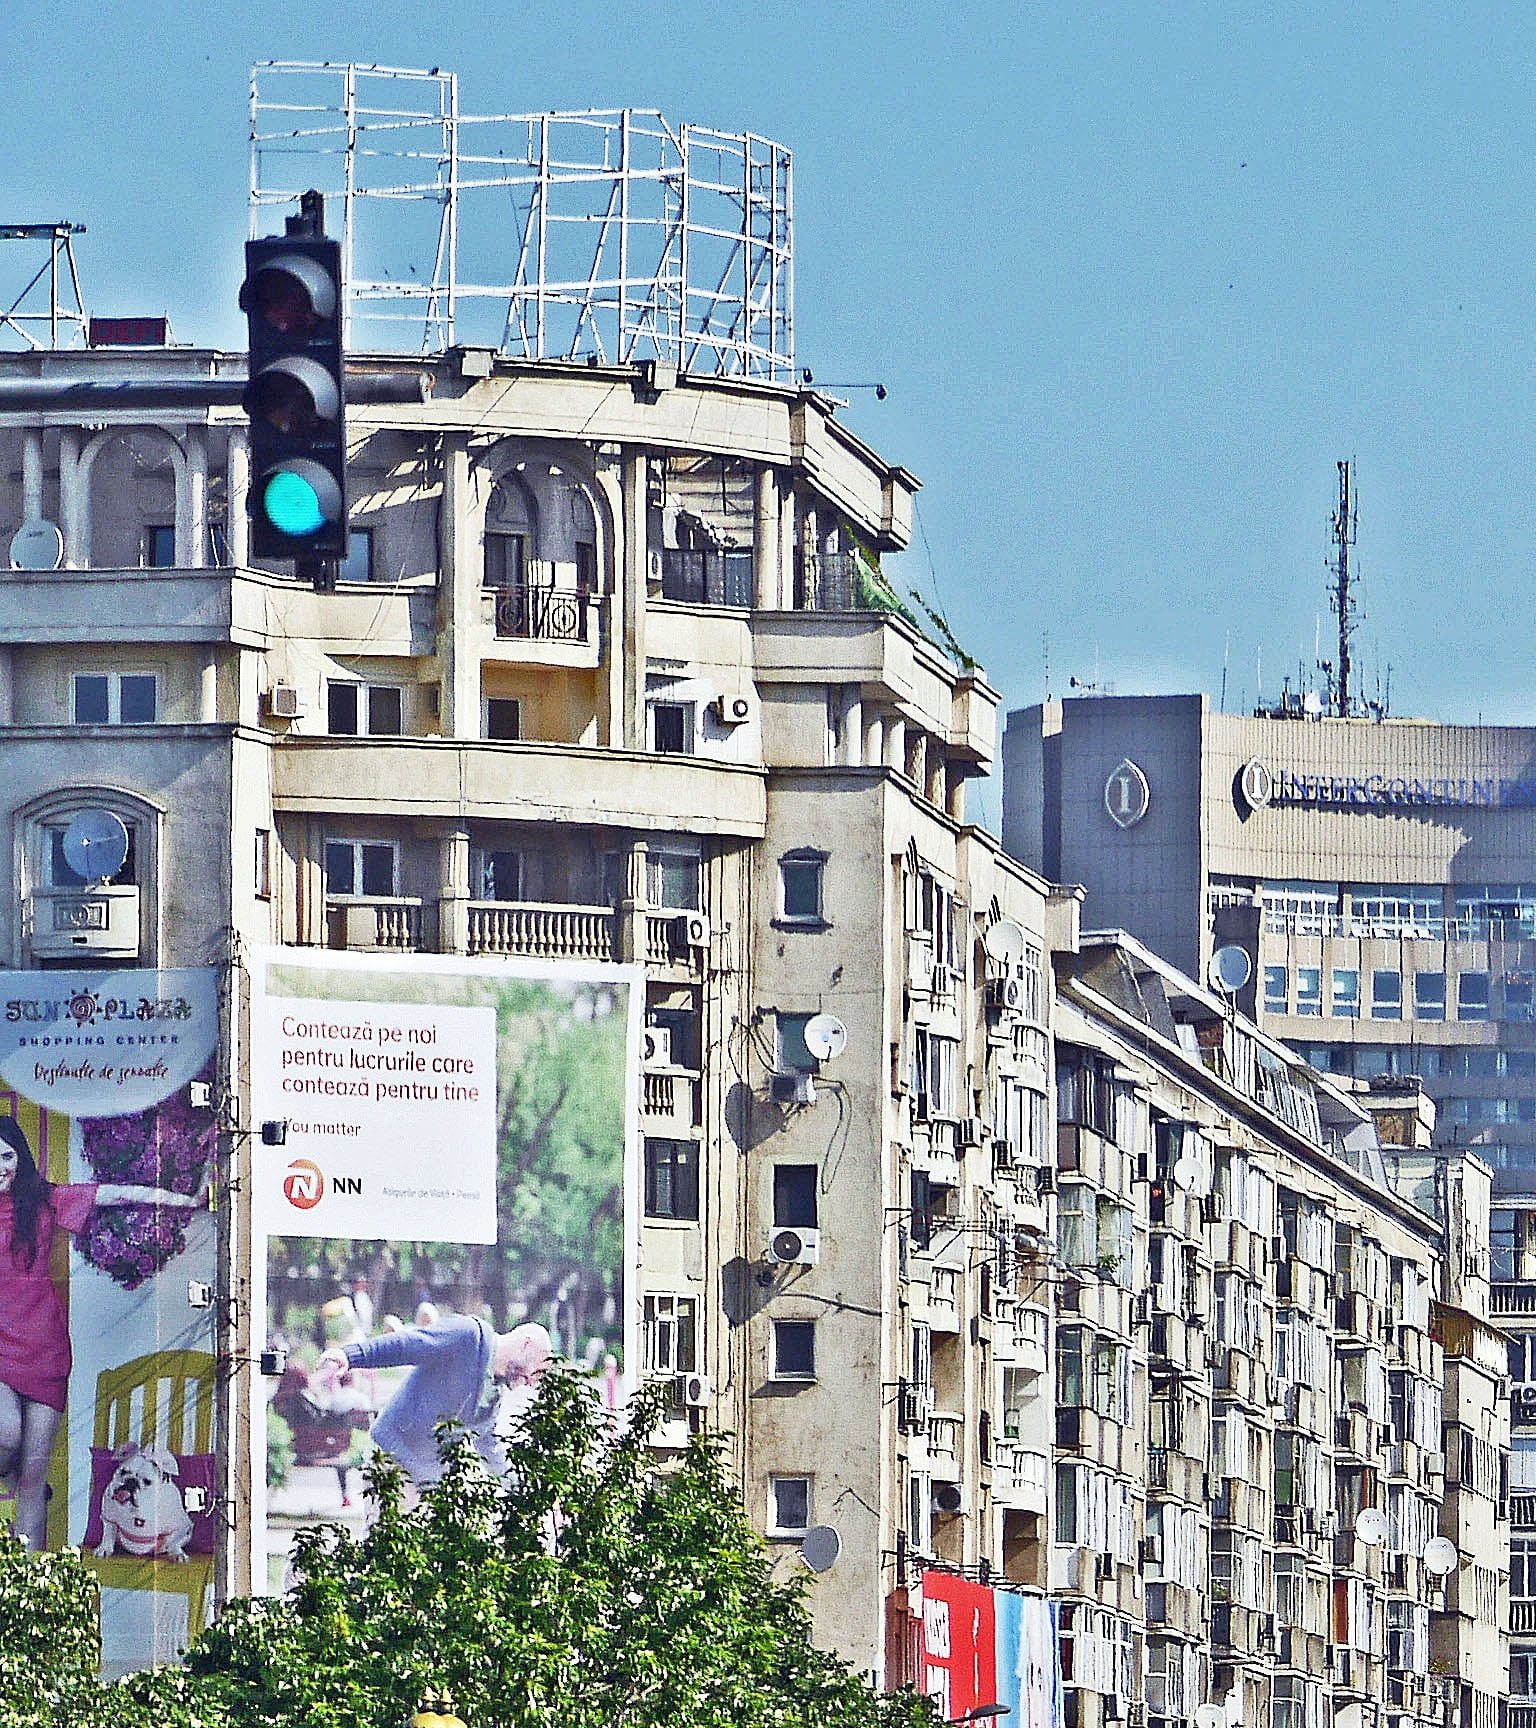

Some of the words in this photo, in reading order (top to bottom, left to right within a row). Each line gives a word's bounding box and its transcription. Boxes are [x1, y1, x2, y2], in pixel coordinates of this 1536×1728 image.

[6, 999, 60, 1022] SUN
[103, 997, 192, 1021] PLAZA
[19, 1036, 104, 1047] SHOPPING
[116, 1035, 178, 1045] CENTER
[282, 1016, 373, 1041] Contează
[379, 1027, 402, 1046] pe
[408, 1025, 437, 1045] noi
[282, 1048, 344, 1069] pentru
[350, 1048, 426, 1073] lucrurile
[432, 1056, 474, 1074] care
[282, 1076, 369, 1098] contează
[376, 1081, 438, 1102] pentru
[445, 1082, 480, 1102] tine
[313, 1122, 362, 1137] matter
[333, 1177, 362, 1195] NN
